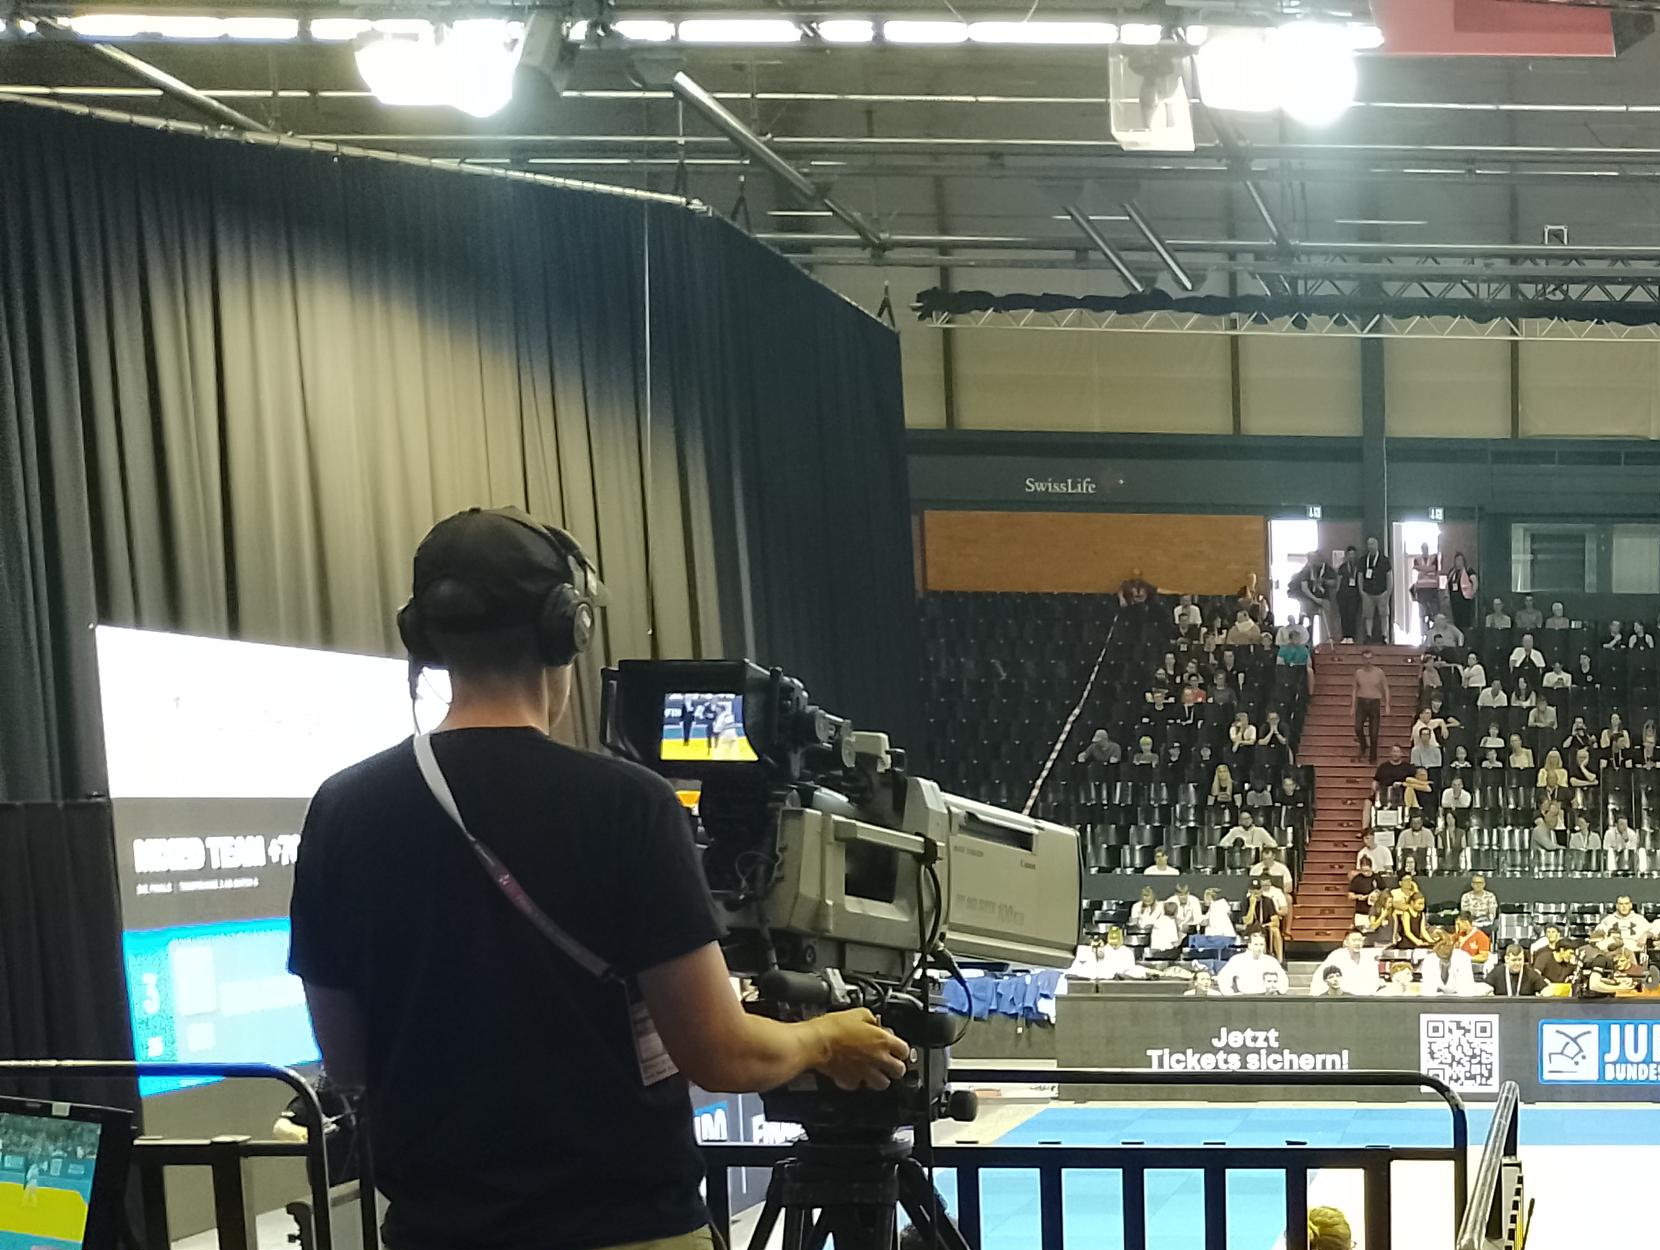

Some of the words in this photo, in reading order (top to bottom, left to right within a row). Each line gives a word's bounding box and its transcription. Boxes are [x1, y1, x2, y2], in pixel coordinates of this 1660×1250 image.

[1025, 477, 1096, 493] SwissLife
[205, 835, 266, 869] TEAM
[1211, 1026, 1279, 1048] Jetzt
[1146, 1048, 1241, 1070] Tickets
[1246, 1048, 1349, 1070] sichern!
